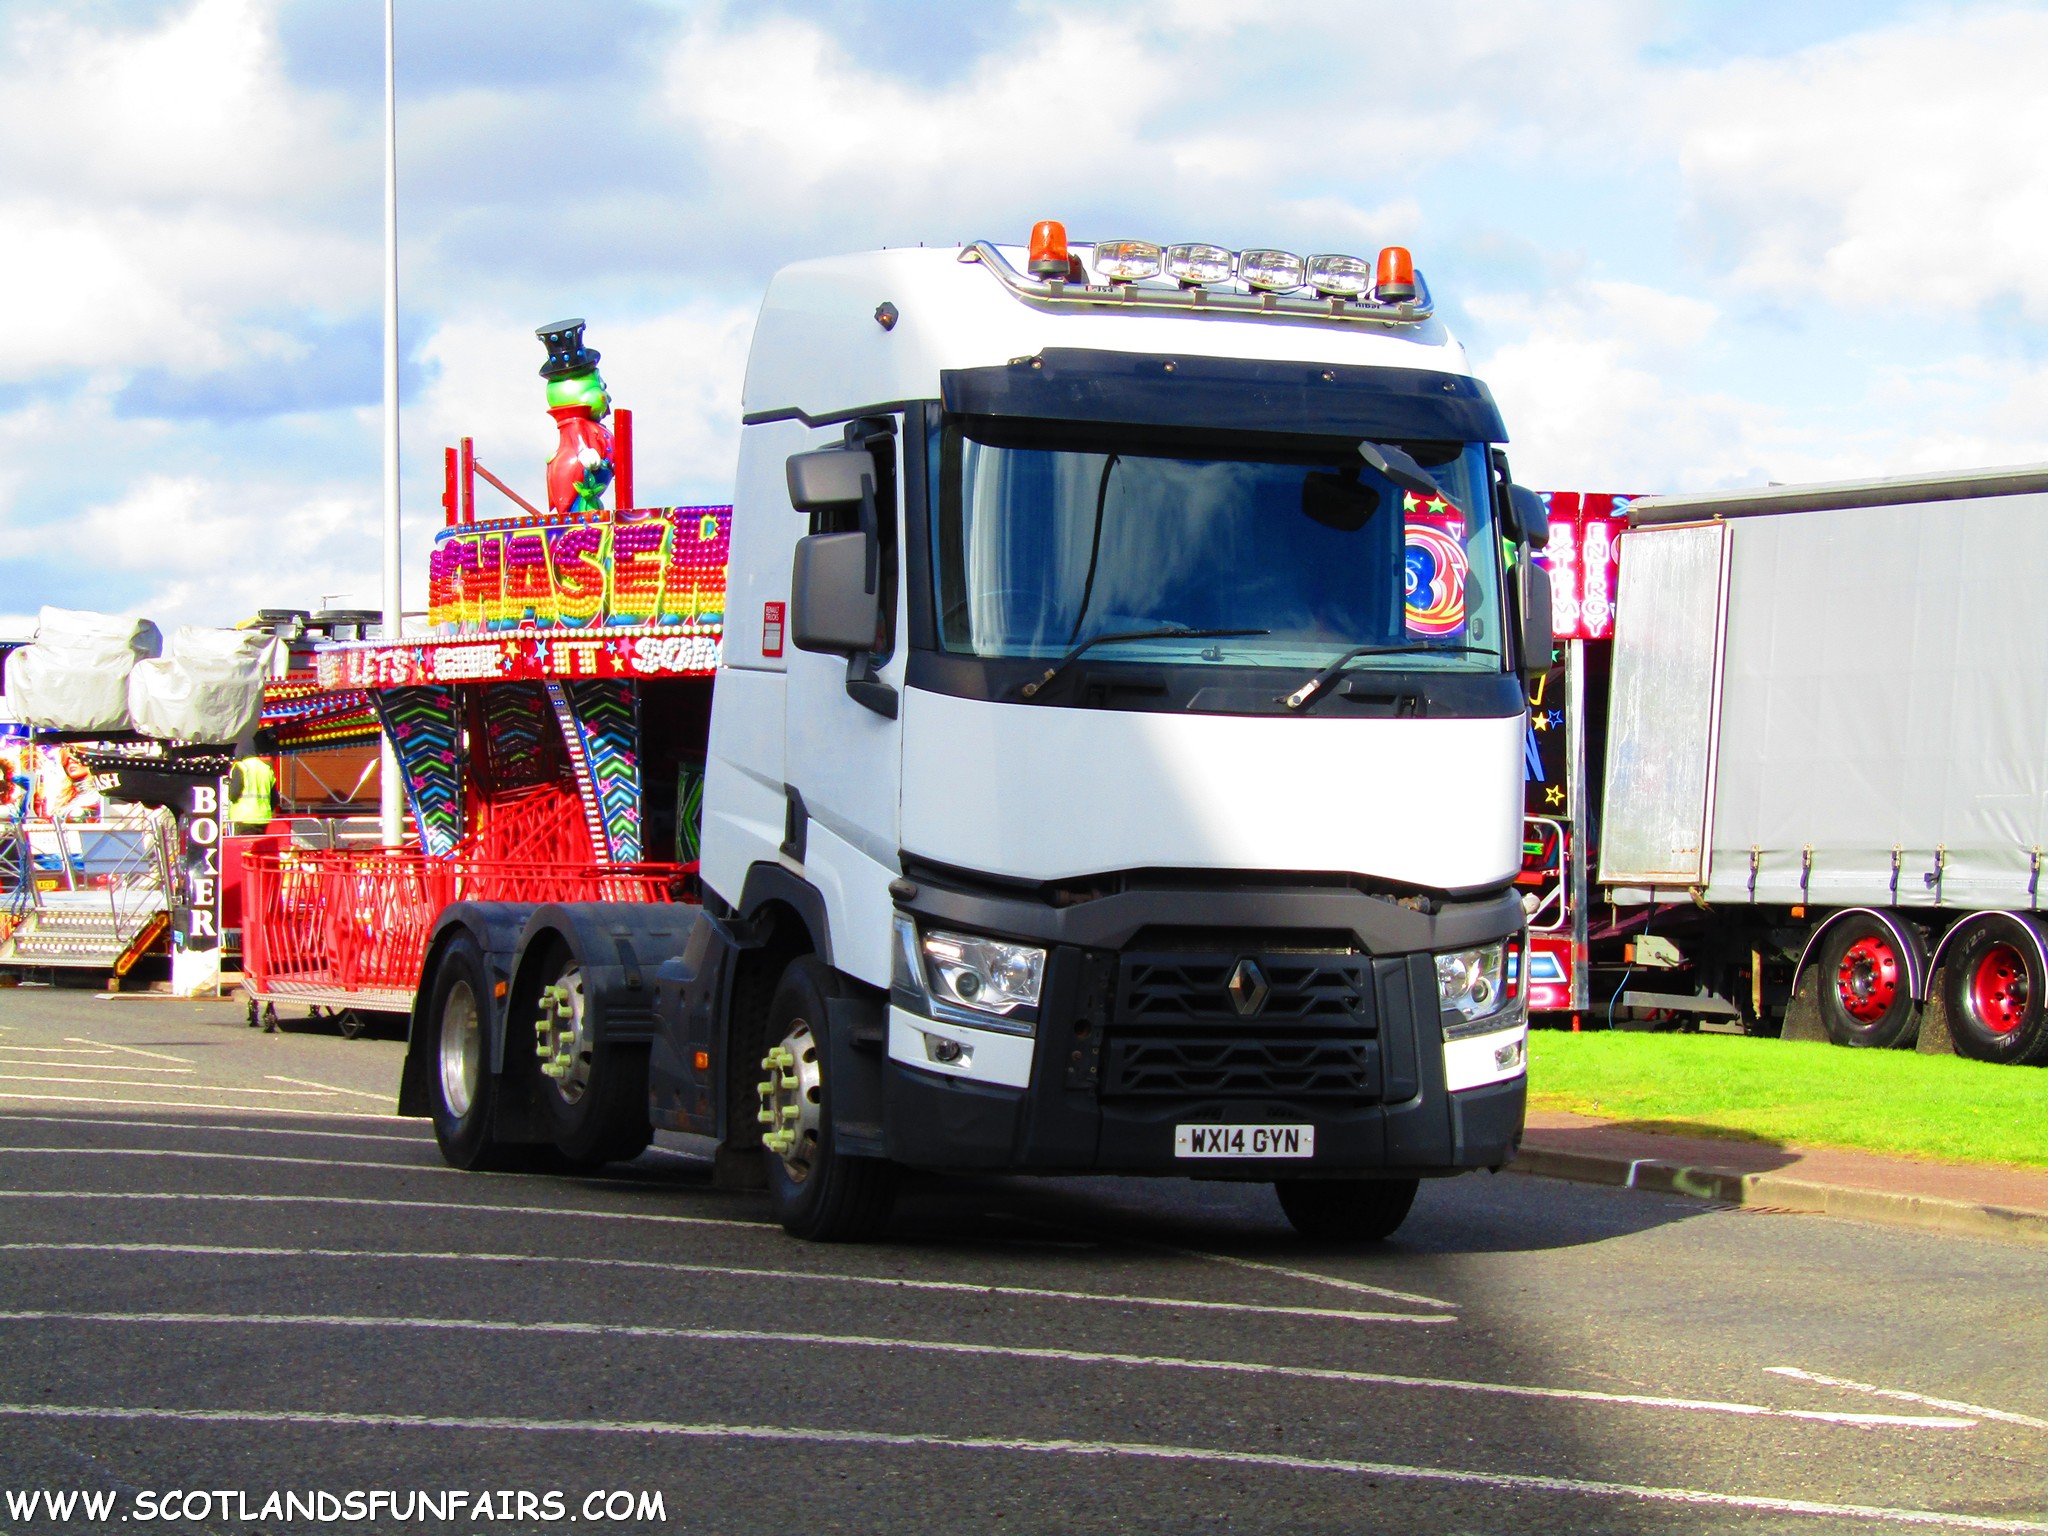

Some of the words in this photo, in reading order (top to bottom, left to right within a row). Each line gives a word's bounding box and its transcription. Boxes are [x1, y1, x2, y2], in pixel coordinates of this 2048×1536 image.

[1582, 522, 1610, 637] ENERGY
[552, 641, 604, 675] IT
[1191, 1128, 1245, 1153] WX14
[1253, 1128, 1300, 1153] GYN
